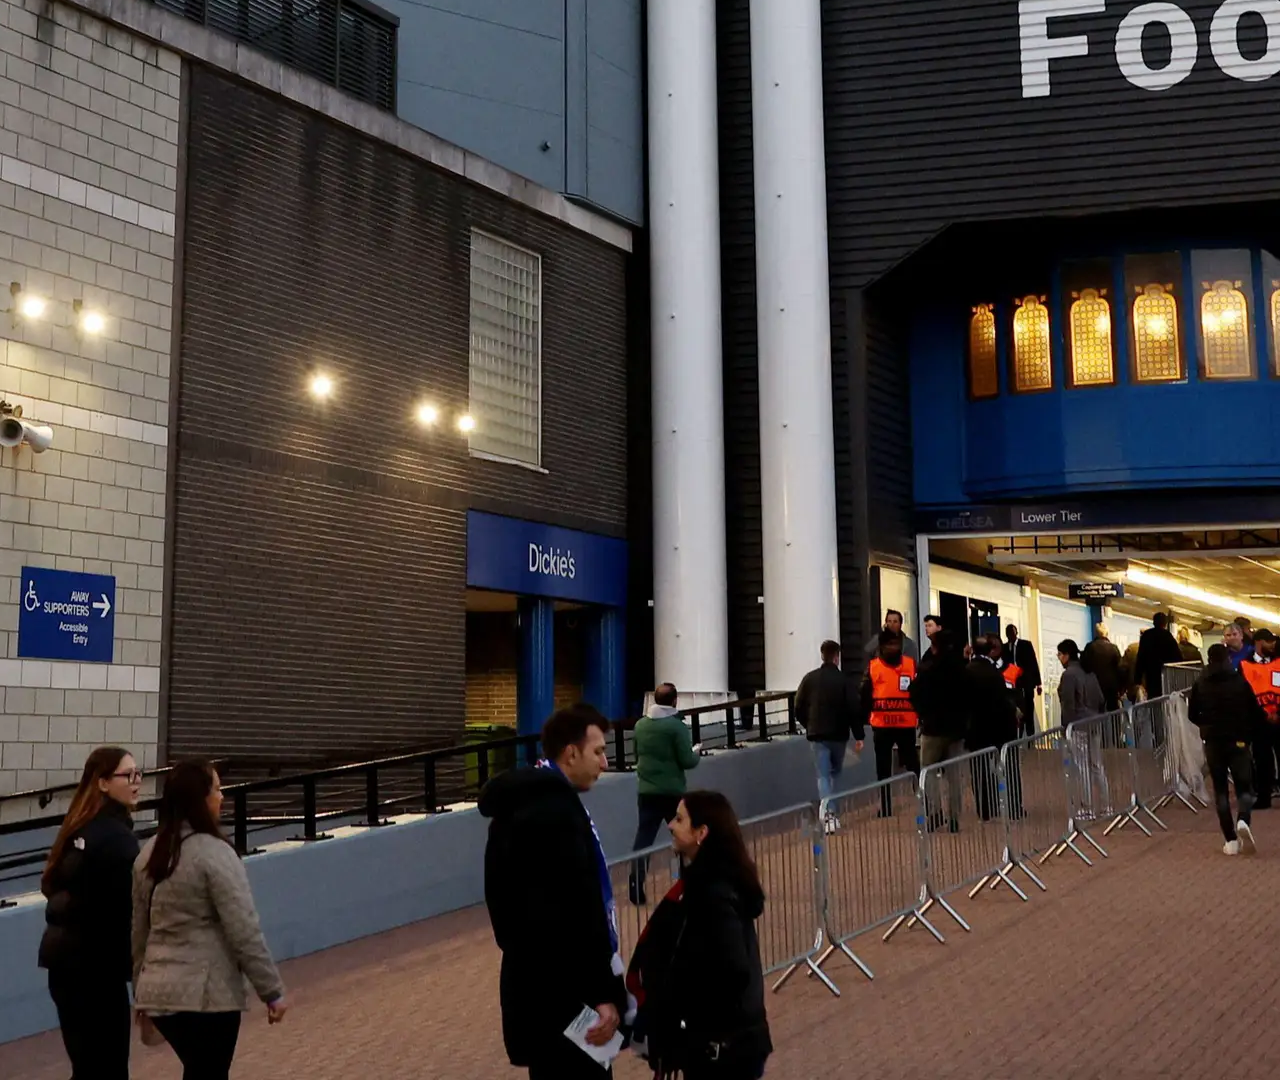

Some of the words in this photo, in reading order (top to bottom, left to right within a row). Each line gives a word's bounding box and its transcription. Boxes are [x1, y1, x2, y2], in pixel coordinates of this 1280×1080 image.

[1021, 512, 1056, 524] Lower
[1060, 510, 1082, 522] Tier
[529, 542, 576, 579] Dickie's
[71, 591, 89, 602] AWAY
[43, 601, 89, 617] SUPPORTERS
[59, 621, 88, 633] Accessible
[73, 633, 88, 646] Entry
